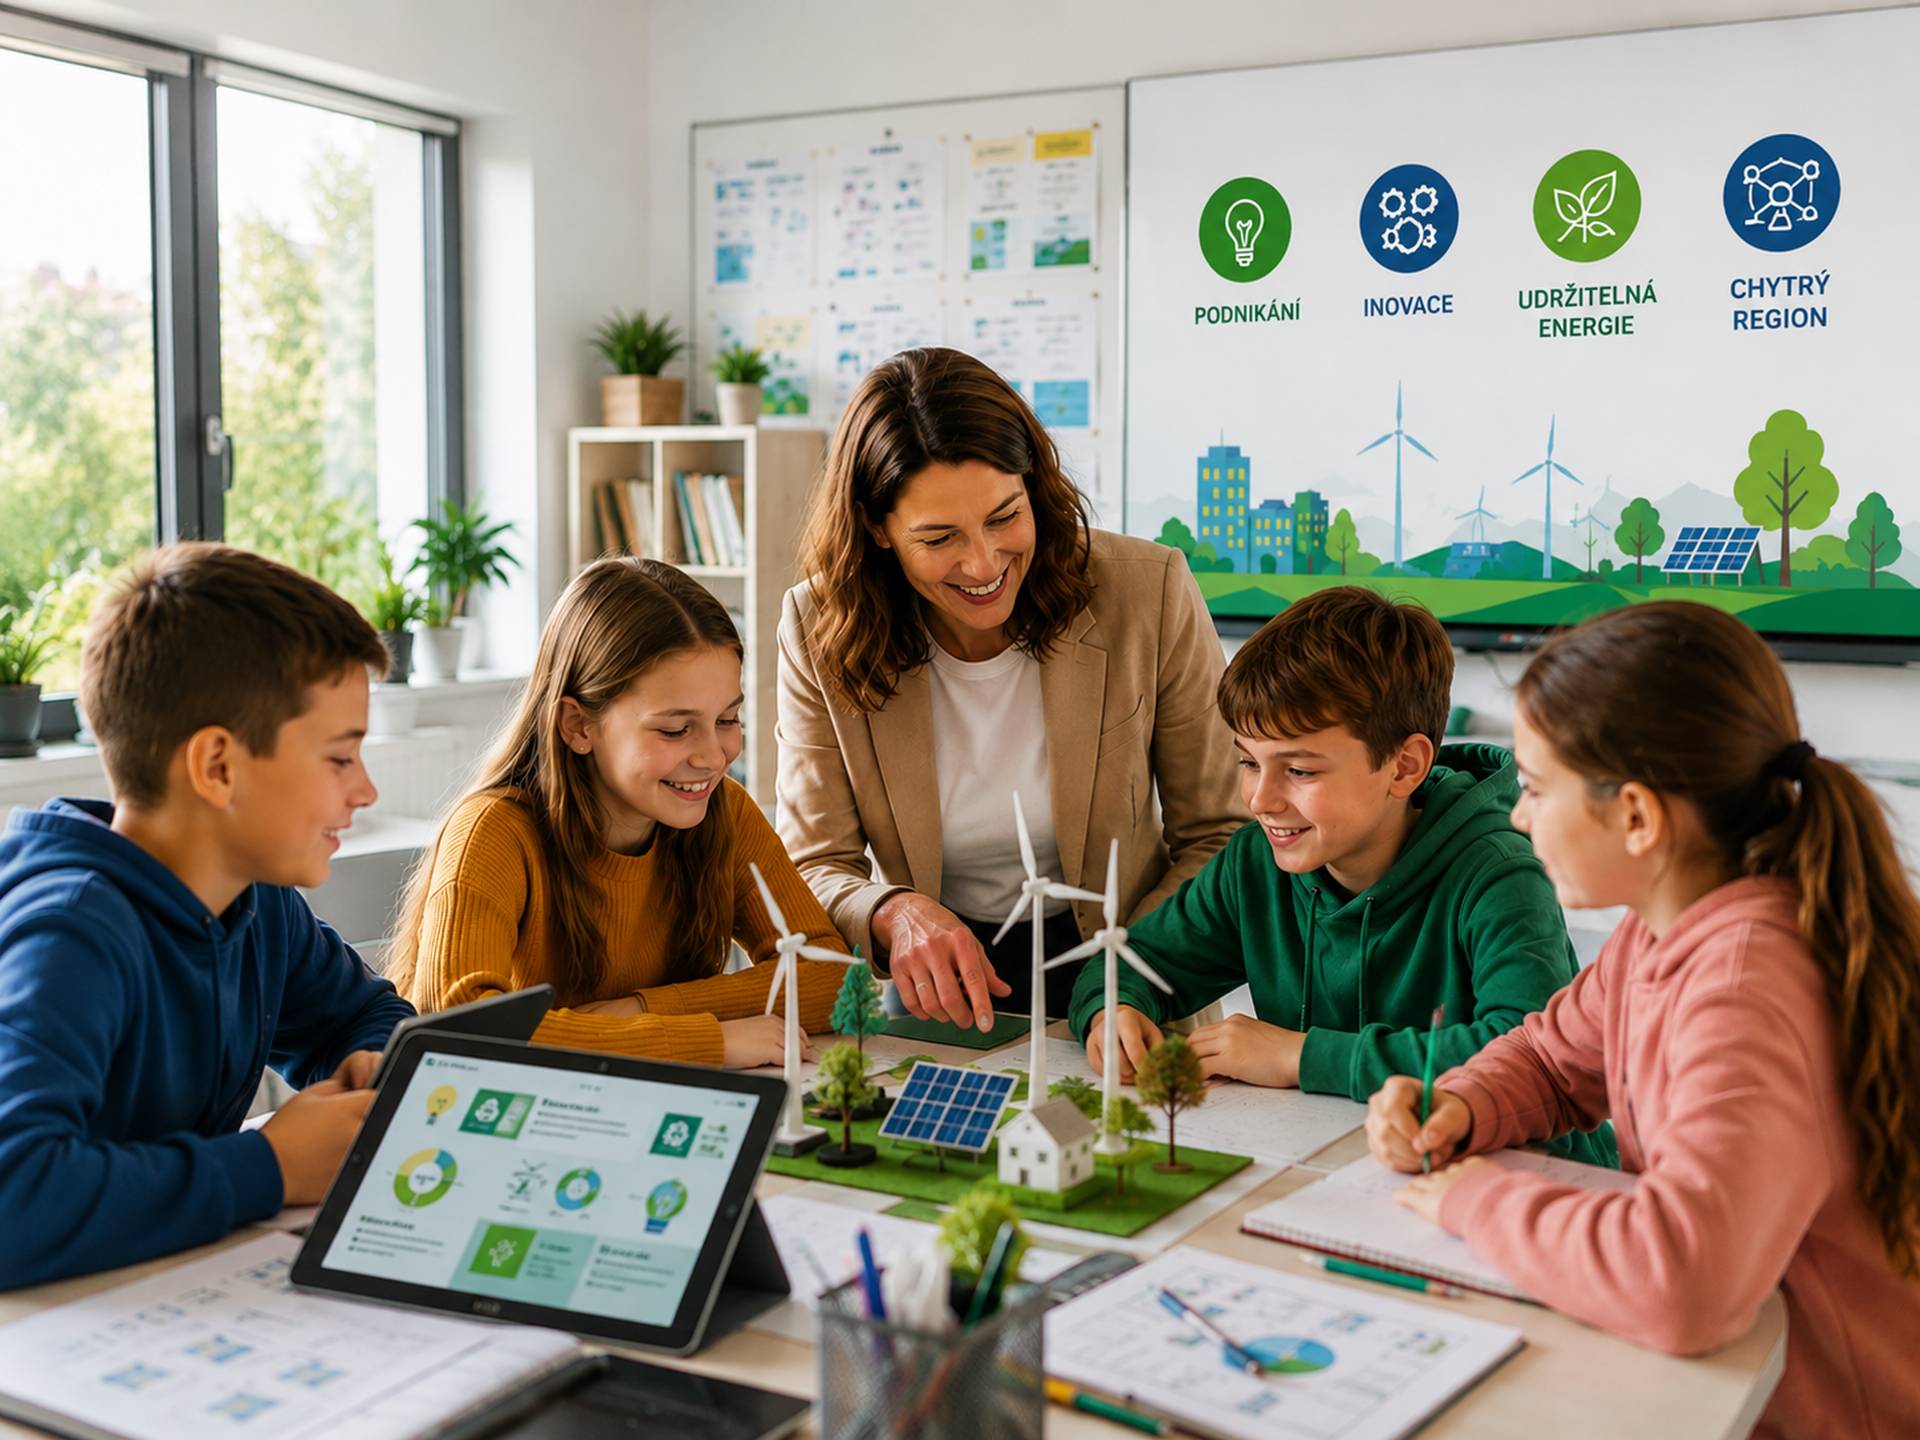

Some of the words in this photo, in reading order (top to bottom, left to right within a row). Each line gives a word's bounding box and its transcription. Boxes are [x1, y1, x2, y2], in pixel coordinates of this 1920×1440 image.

[1518, 278, 1658, 310] UDRŽITELNÁ
[1730, 269, 1831, 299] CHYTRÝ
[1195, 298, 1301, 325] PODNIKÁNÍ
[1364, 294, 1454, 317] INOVACE
[1733, 306, 1827, 331] REGION
[1539, 315, 1635, 338] ENERGIE
